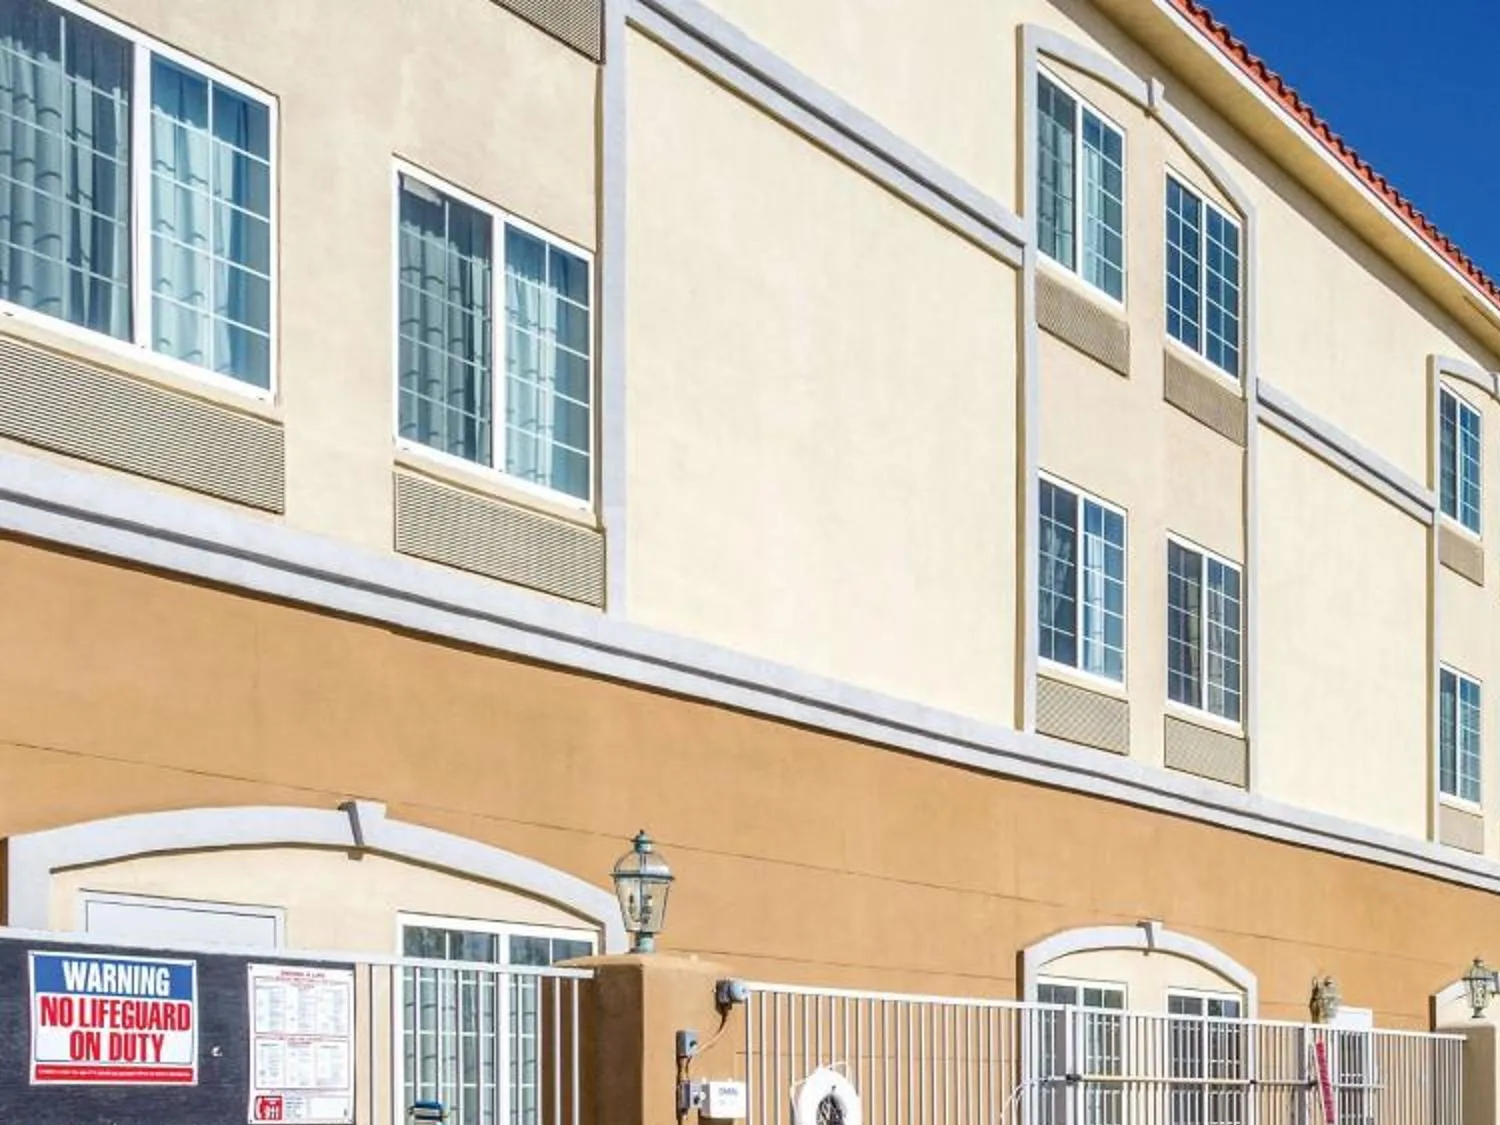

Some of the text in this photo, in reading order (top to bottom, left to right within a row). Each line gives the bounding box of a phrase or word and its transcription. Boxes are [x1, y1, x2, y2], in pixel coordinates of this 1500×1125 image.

[61, 960, 170, 997] WARNING
[40, 996, 191, 1032] NO LIFEGUARD
[69, 1030, 165, 1063] ON DUTY
